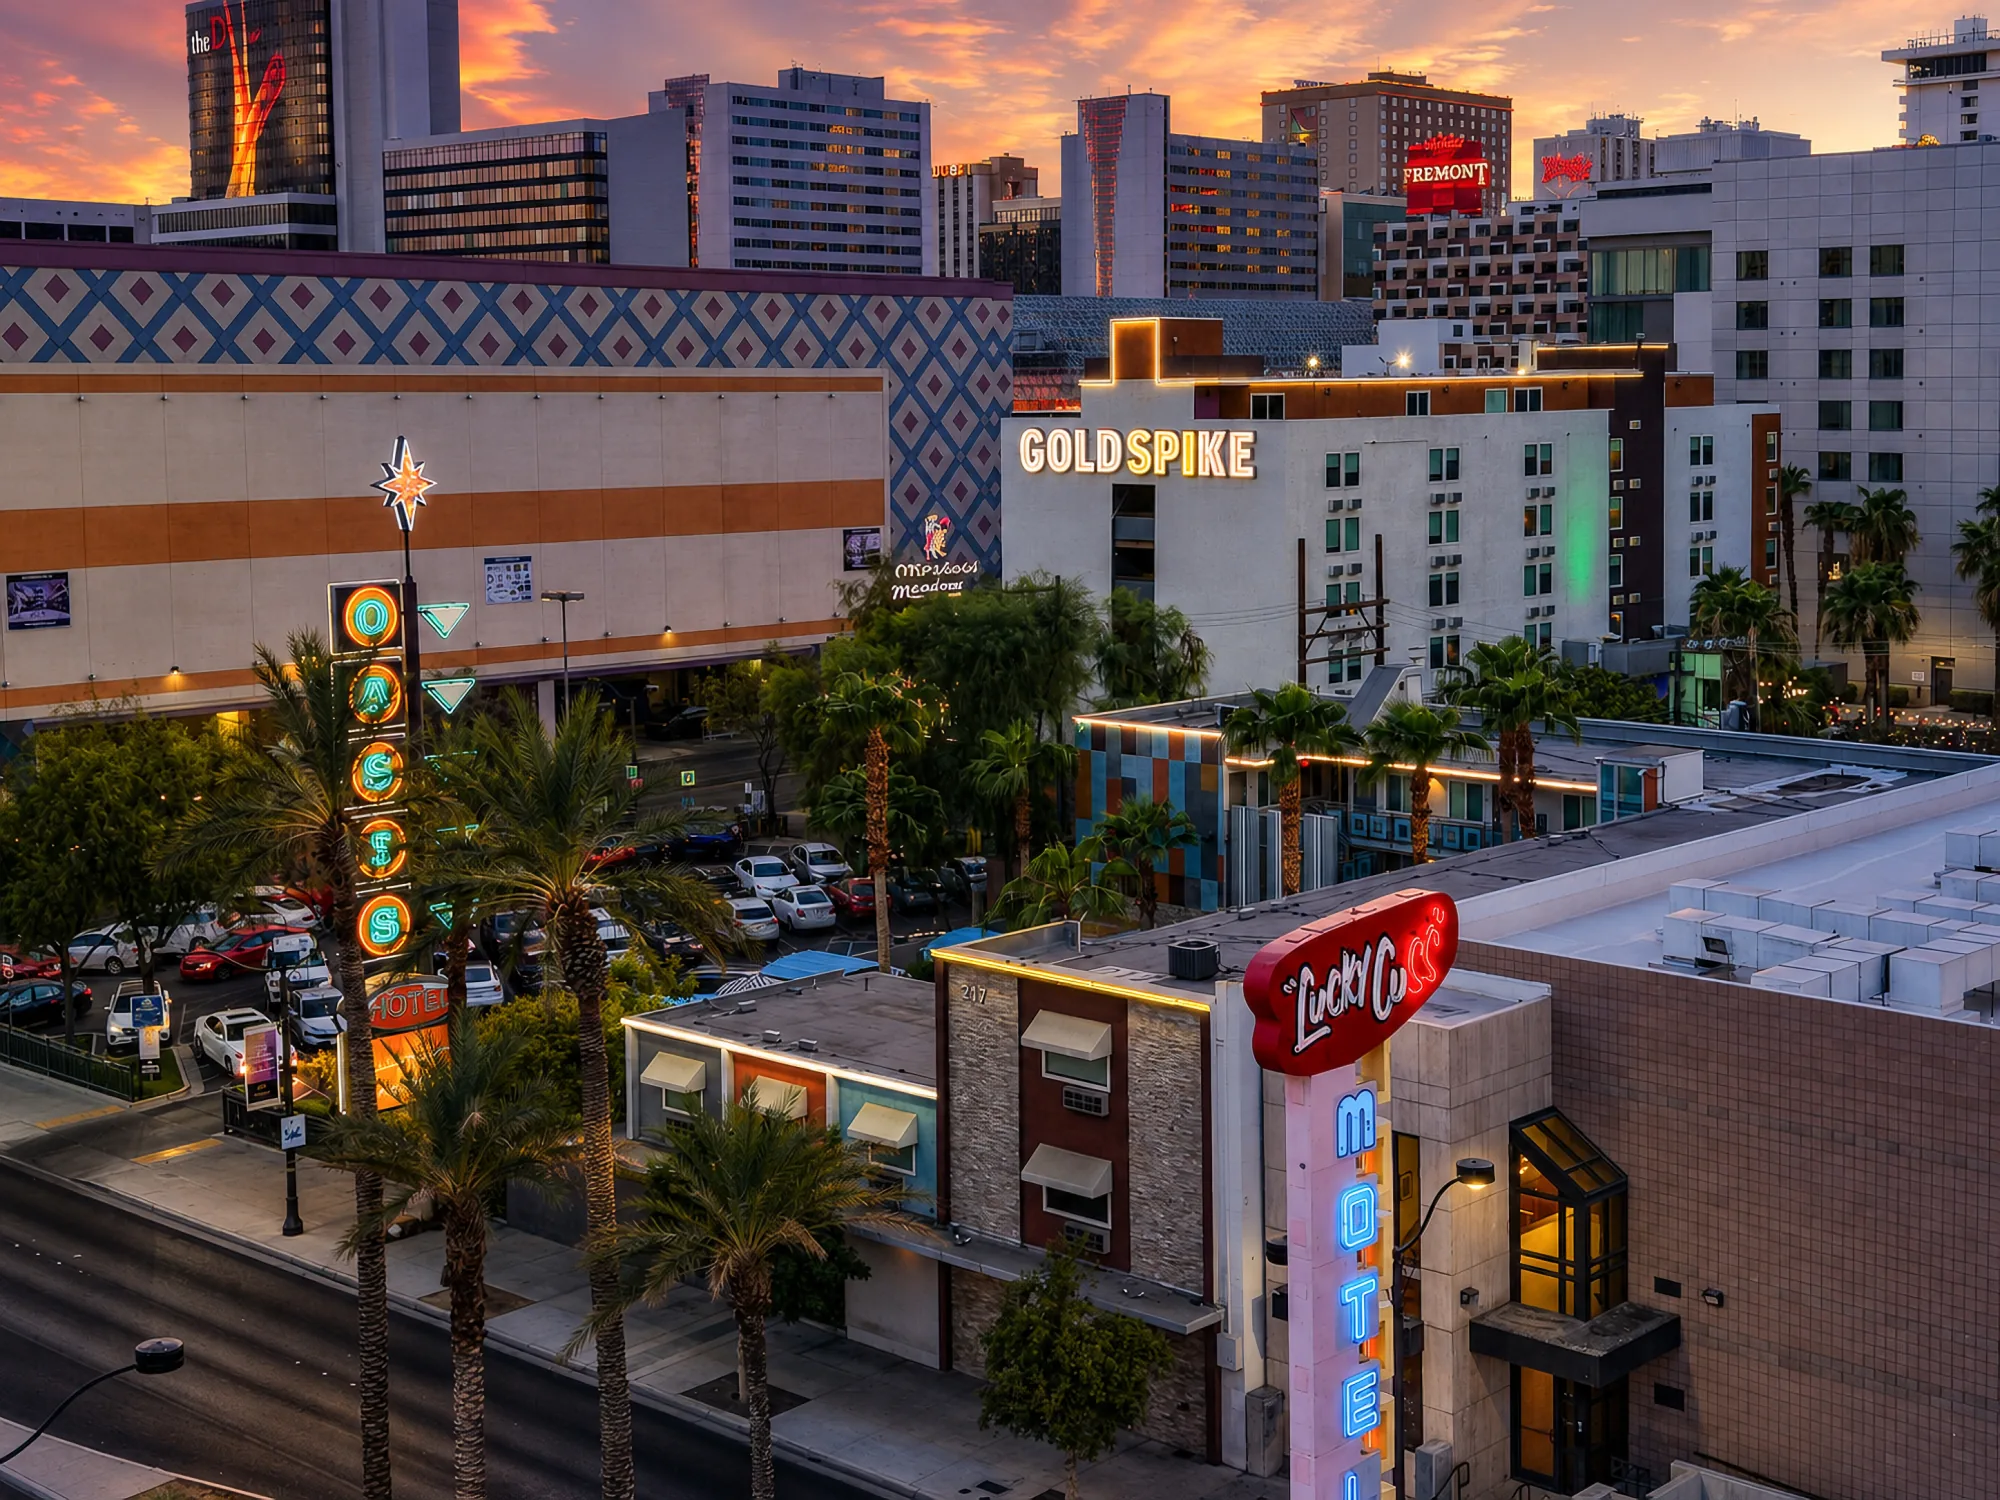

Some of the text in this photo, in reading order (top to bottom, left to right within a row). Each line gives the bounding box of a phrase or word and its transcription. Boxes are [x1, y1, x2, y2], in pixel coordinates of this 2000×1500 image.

[191, 15, 226, 54] the D
[1403, 162, 1488, 185] FREMONT
[1019, 427, 1257, 477] GOLD SPIKE
[369, 988, 449, 1021] HOTEL
[960, 984, 986, 1003] 217
